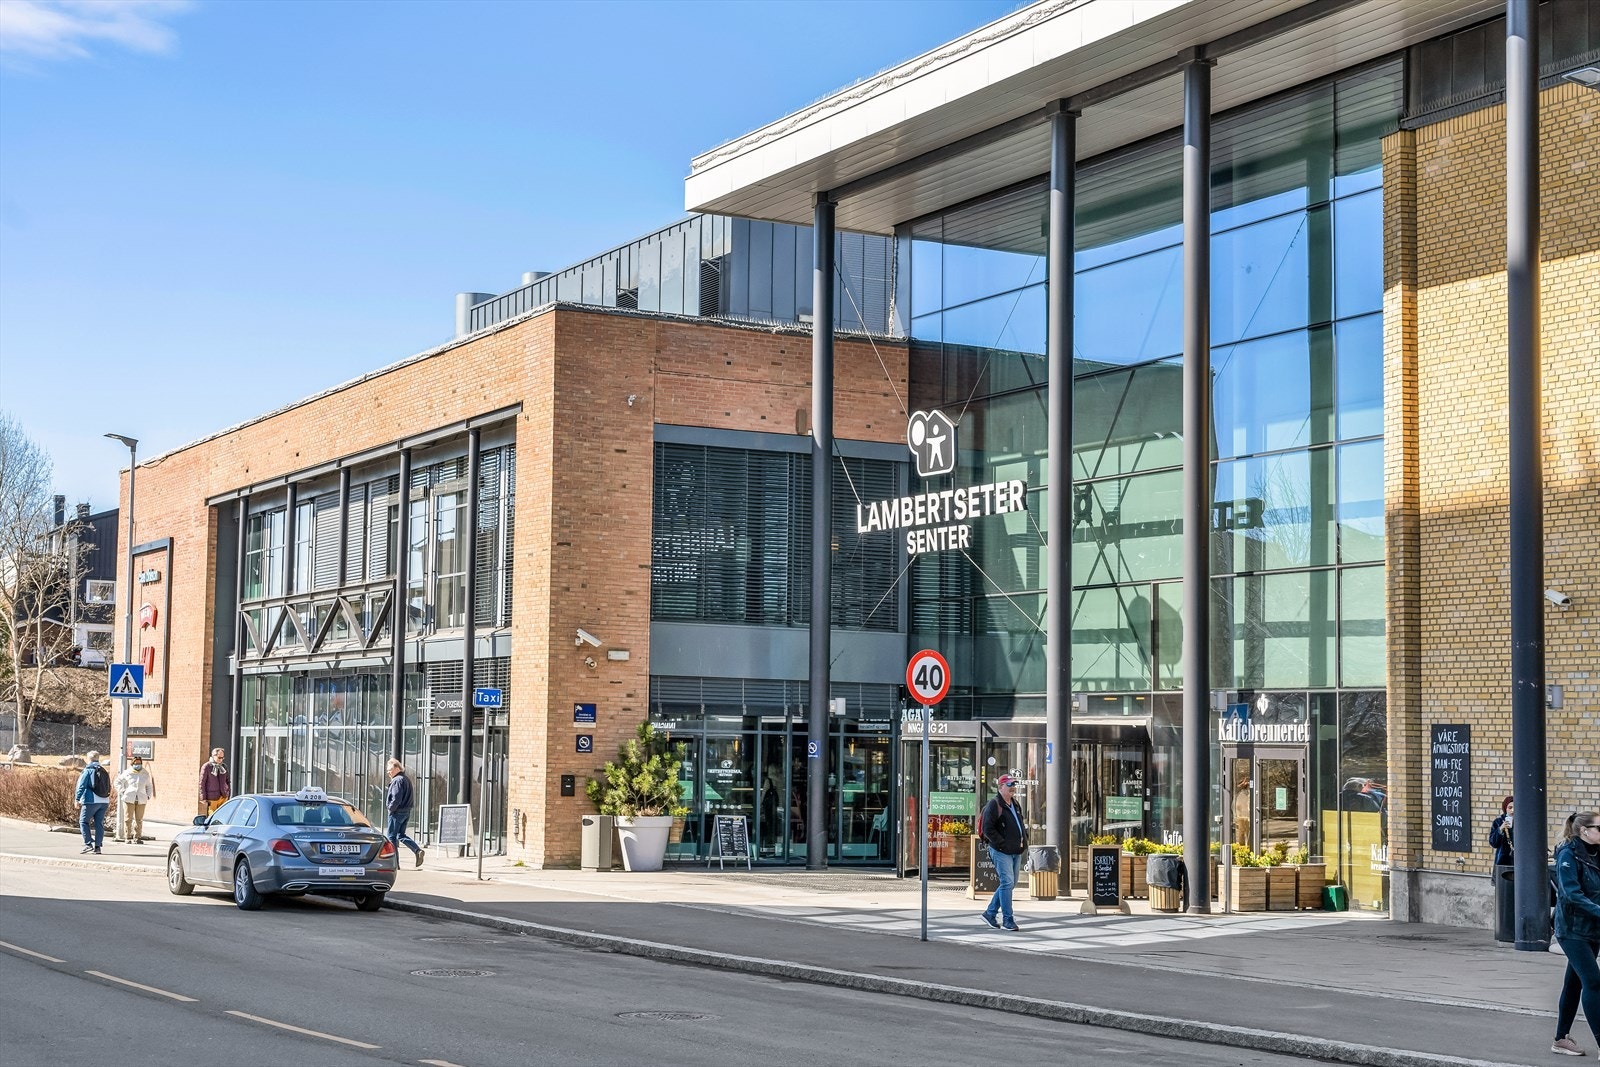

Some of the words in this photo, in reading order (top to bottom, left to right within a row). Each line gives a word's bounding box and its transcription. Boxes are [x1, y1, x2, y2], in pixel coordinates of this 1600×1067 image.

[857, 479, 1024, 534] LAMBERTSETER
[906, 525, 970, 555] SENTER
[915, 664, 943, 691] 40
[477, 692, 500, 703] Taxi
[907, 722, 937, 734] INNGAG
[938, 723, 948, 734] 21
[1218, 718, 1310, 743] Kaffebrenneriet
[1437, 728, 1459, 743] VÅRE
[1434, 758, 1463, 771] MAN-FRE
[1441, 770, 1459, 784] 8-21
[1435, 785, 1463, 799] LØRDAG
[1442, 799, 1460, 814] 9-19
[1436, 814, 1463, 828] SØNDAG
[1443, 828, 1460, 843] 9-18
[338, 845, 359, 853] 30811
